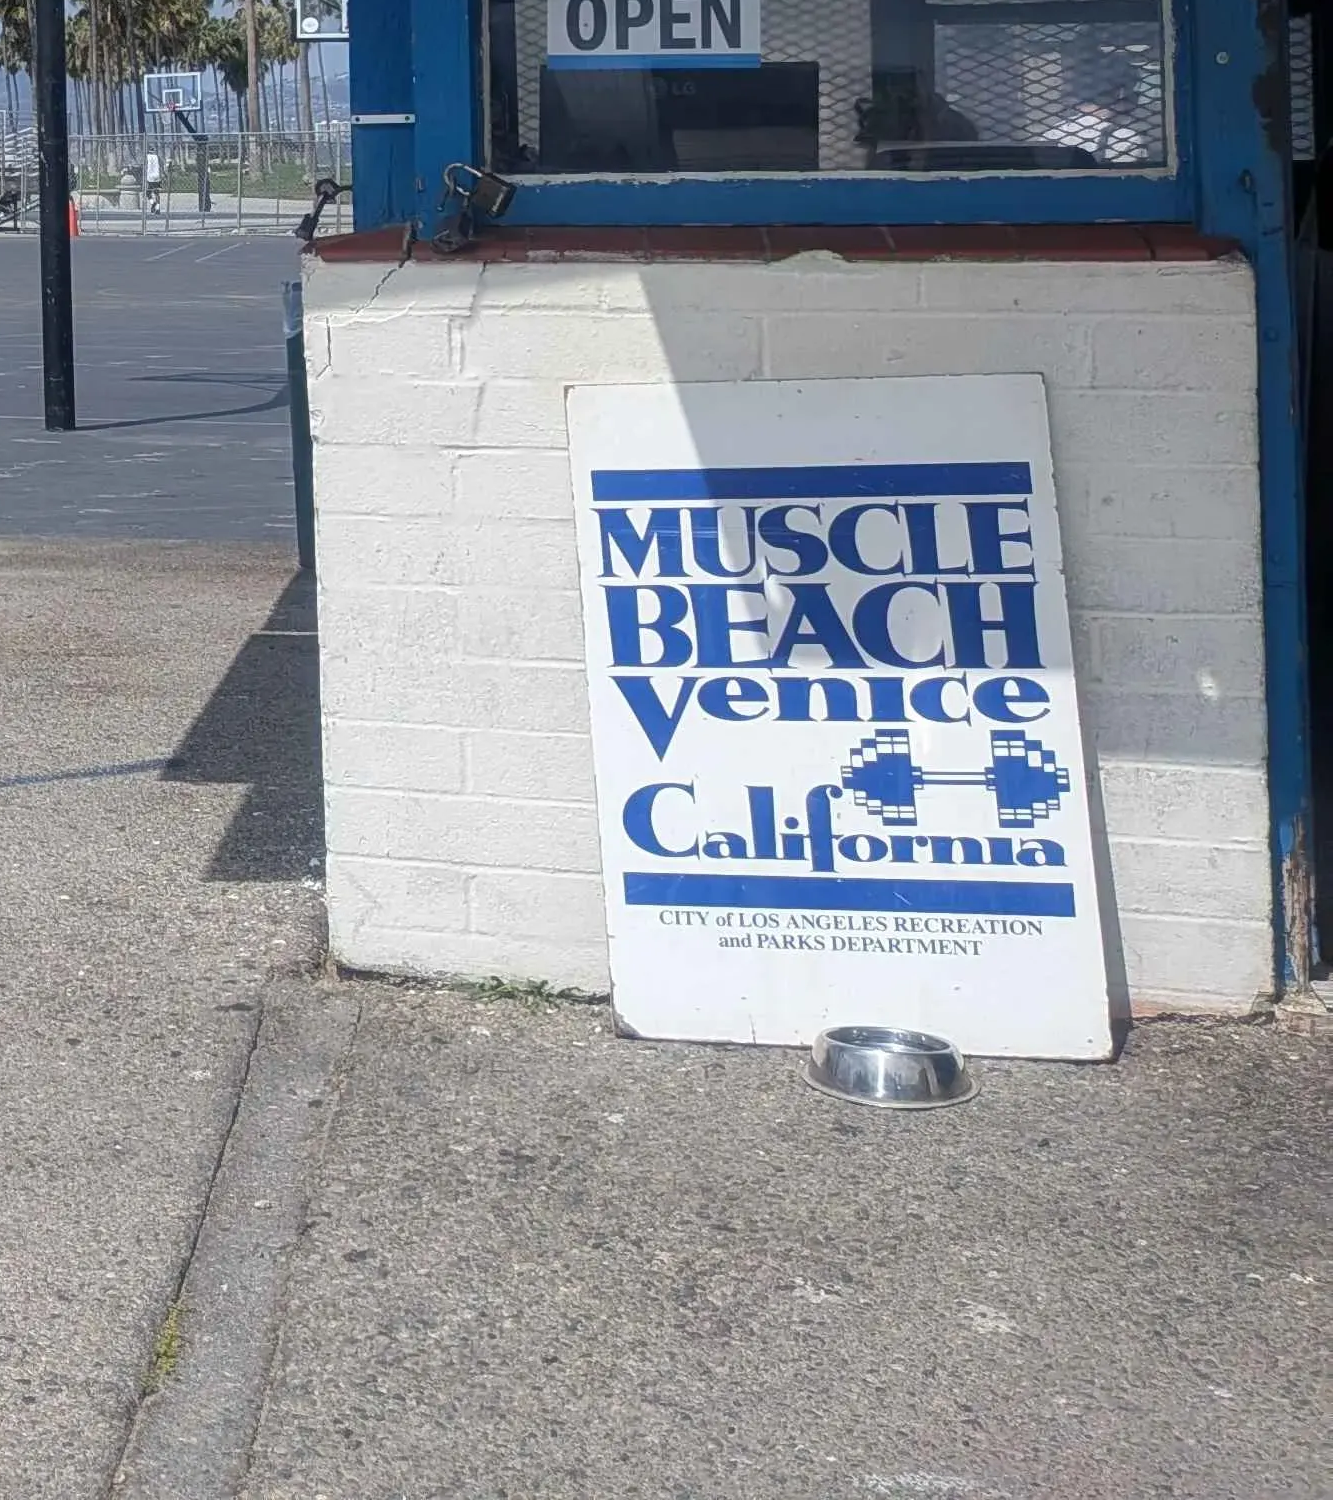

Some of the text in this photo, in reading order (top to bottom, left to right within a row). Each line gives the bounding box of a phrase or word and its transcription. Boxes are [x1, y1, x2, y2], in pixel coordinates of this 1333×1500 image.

[590, 499, 1035, 580] MUSCLE
[598, 579, 1045, 673] BEACH
[608, 670, 1051, 763] Venice
[622, 780, 1067, 873] California
[659, 910, 1044, 935] CITY of LOS ANGELES RECREATION
[719, 933, 983, 955] and PARKS DEPARTMENT
